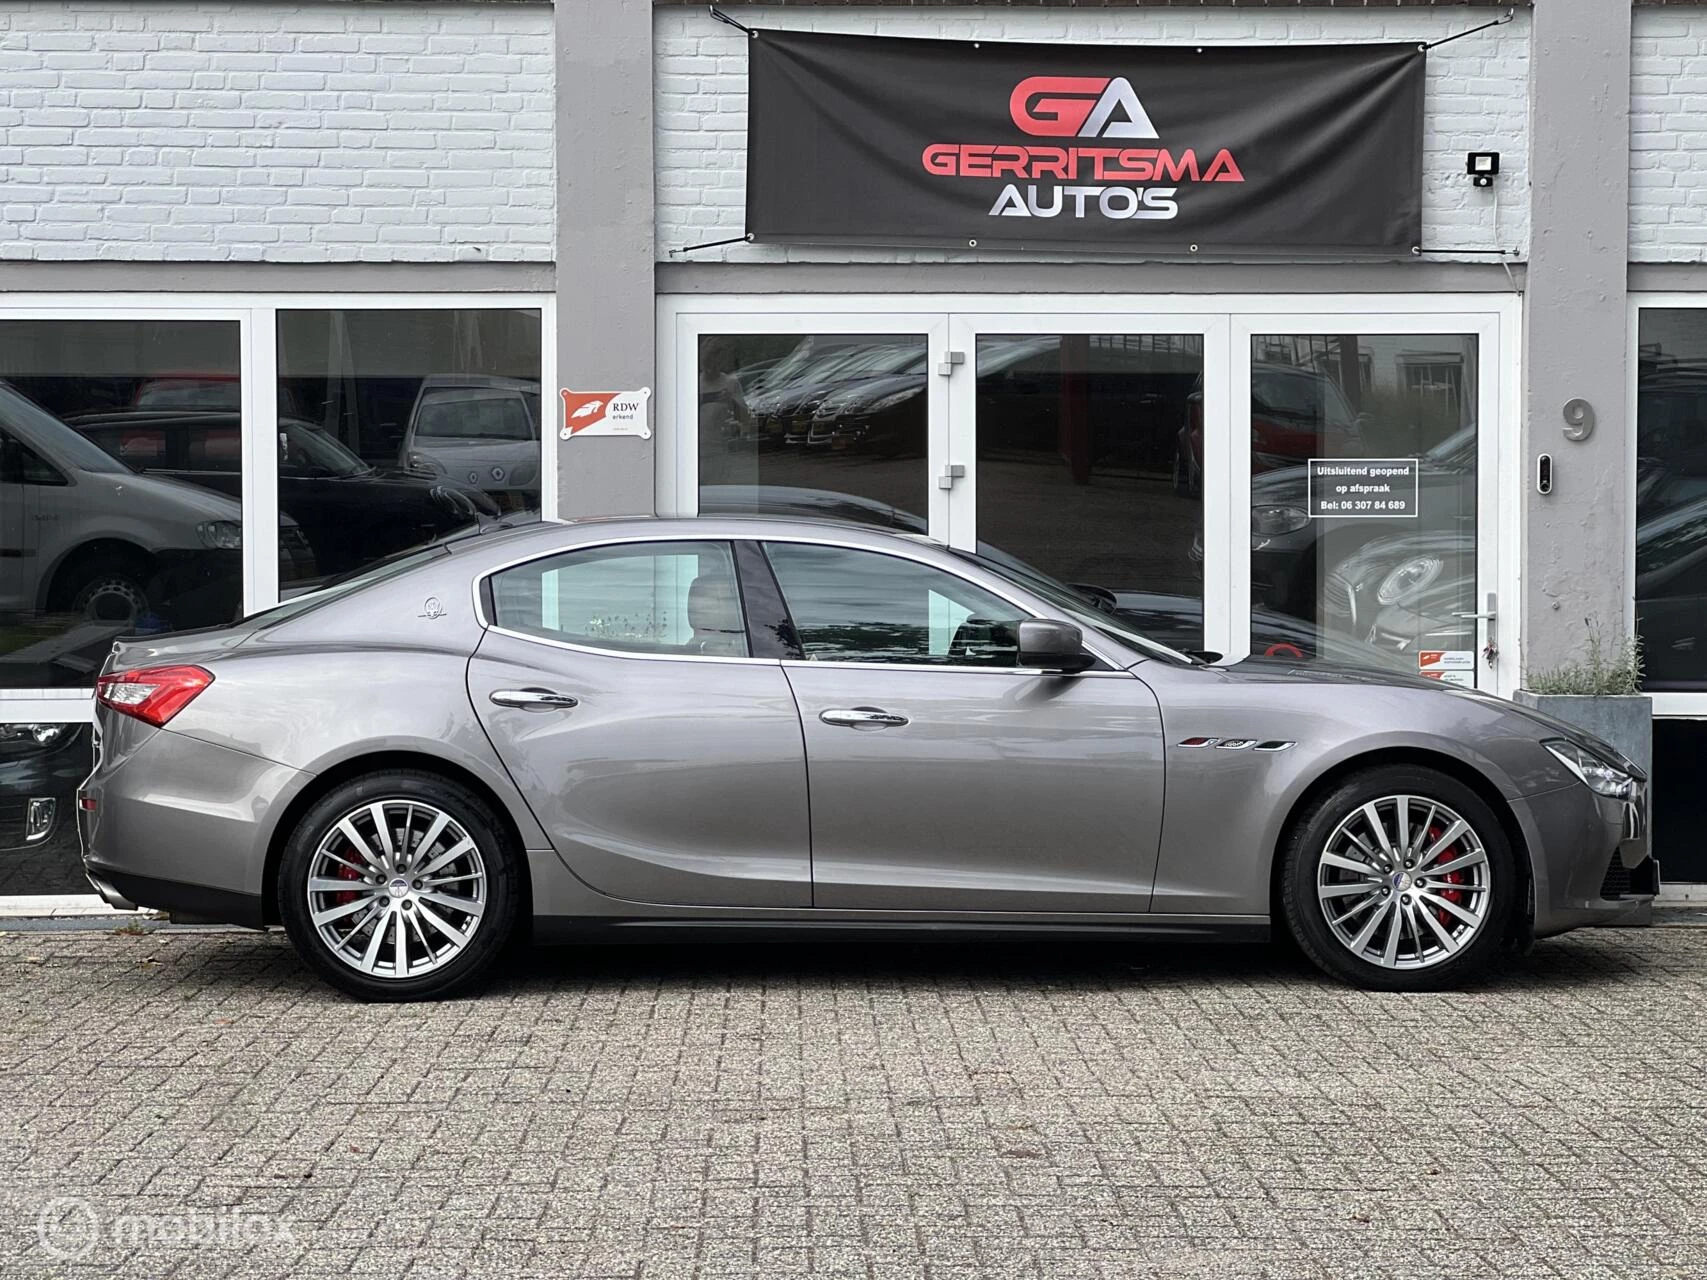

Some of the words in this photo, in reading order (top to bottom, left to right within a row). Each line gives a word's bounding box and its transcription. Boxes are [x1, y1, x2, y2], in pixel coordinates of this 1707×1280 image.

[1009, 76, 1160, 139] GA
[922, 143, 1245, 182] GERRITSMA
[988, 183, 1179, 220] AUTO'S
[613, 403, 639, 411] RDW
[1561, 398, 1596, 441] 9
[1317, 466, 1368, 475] Uitsluitend
[1369, 466, 1410, 477] geopend
[1335, 485, 1348, 494] op
[1349, 483, 1391, 494] afspraak
[1320, 501, 1339, 510] Bel:
[1341, 501, 1353, 510] 06
[1354, 501, 1372, 510] 307
[1374, 501, 1386, 510] 84
[1388, 501, 1406, 510] 689
